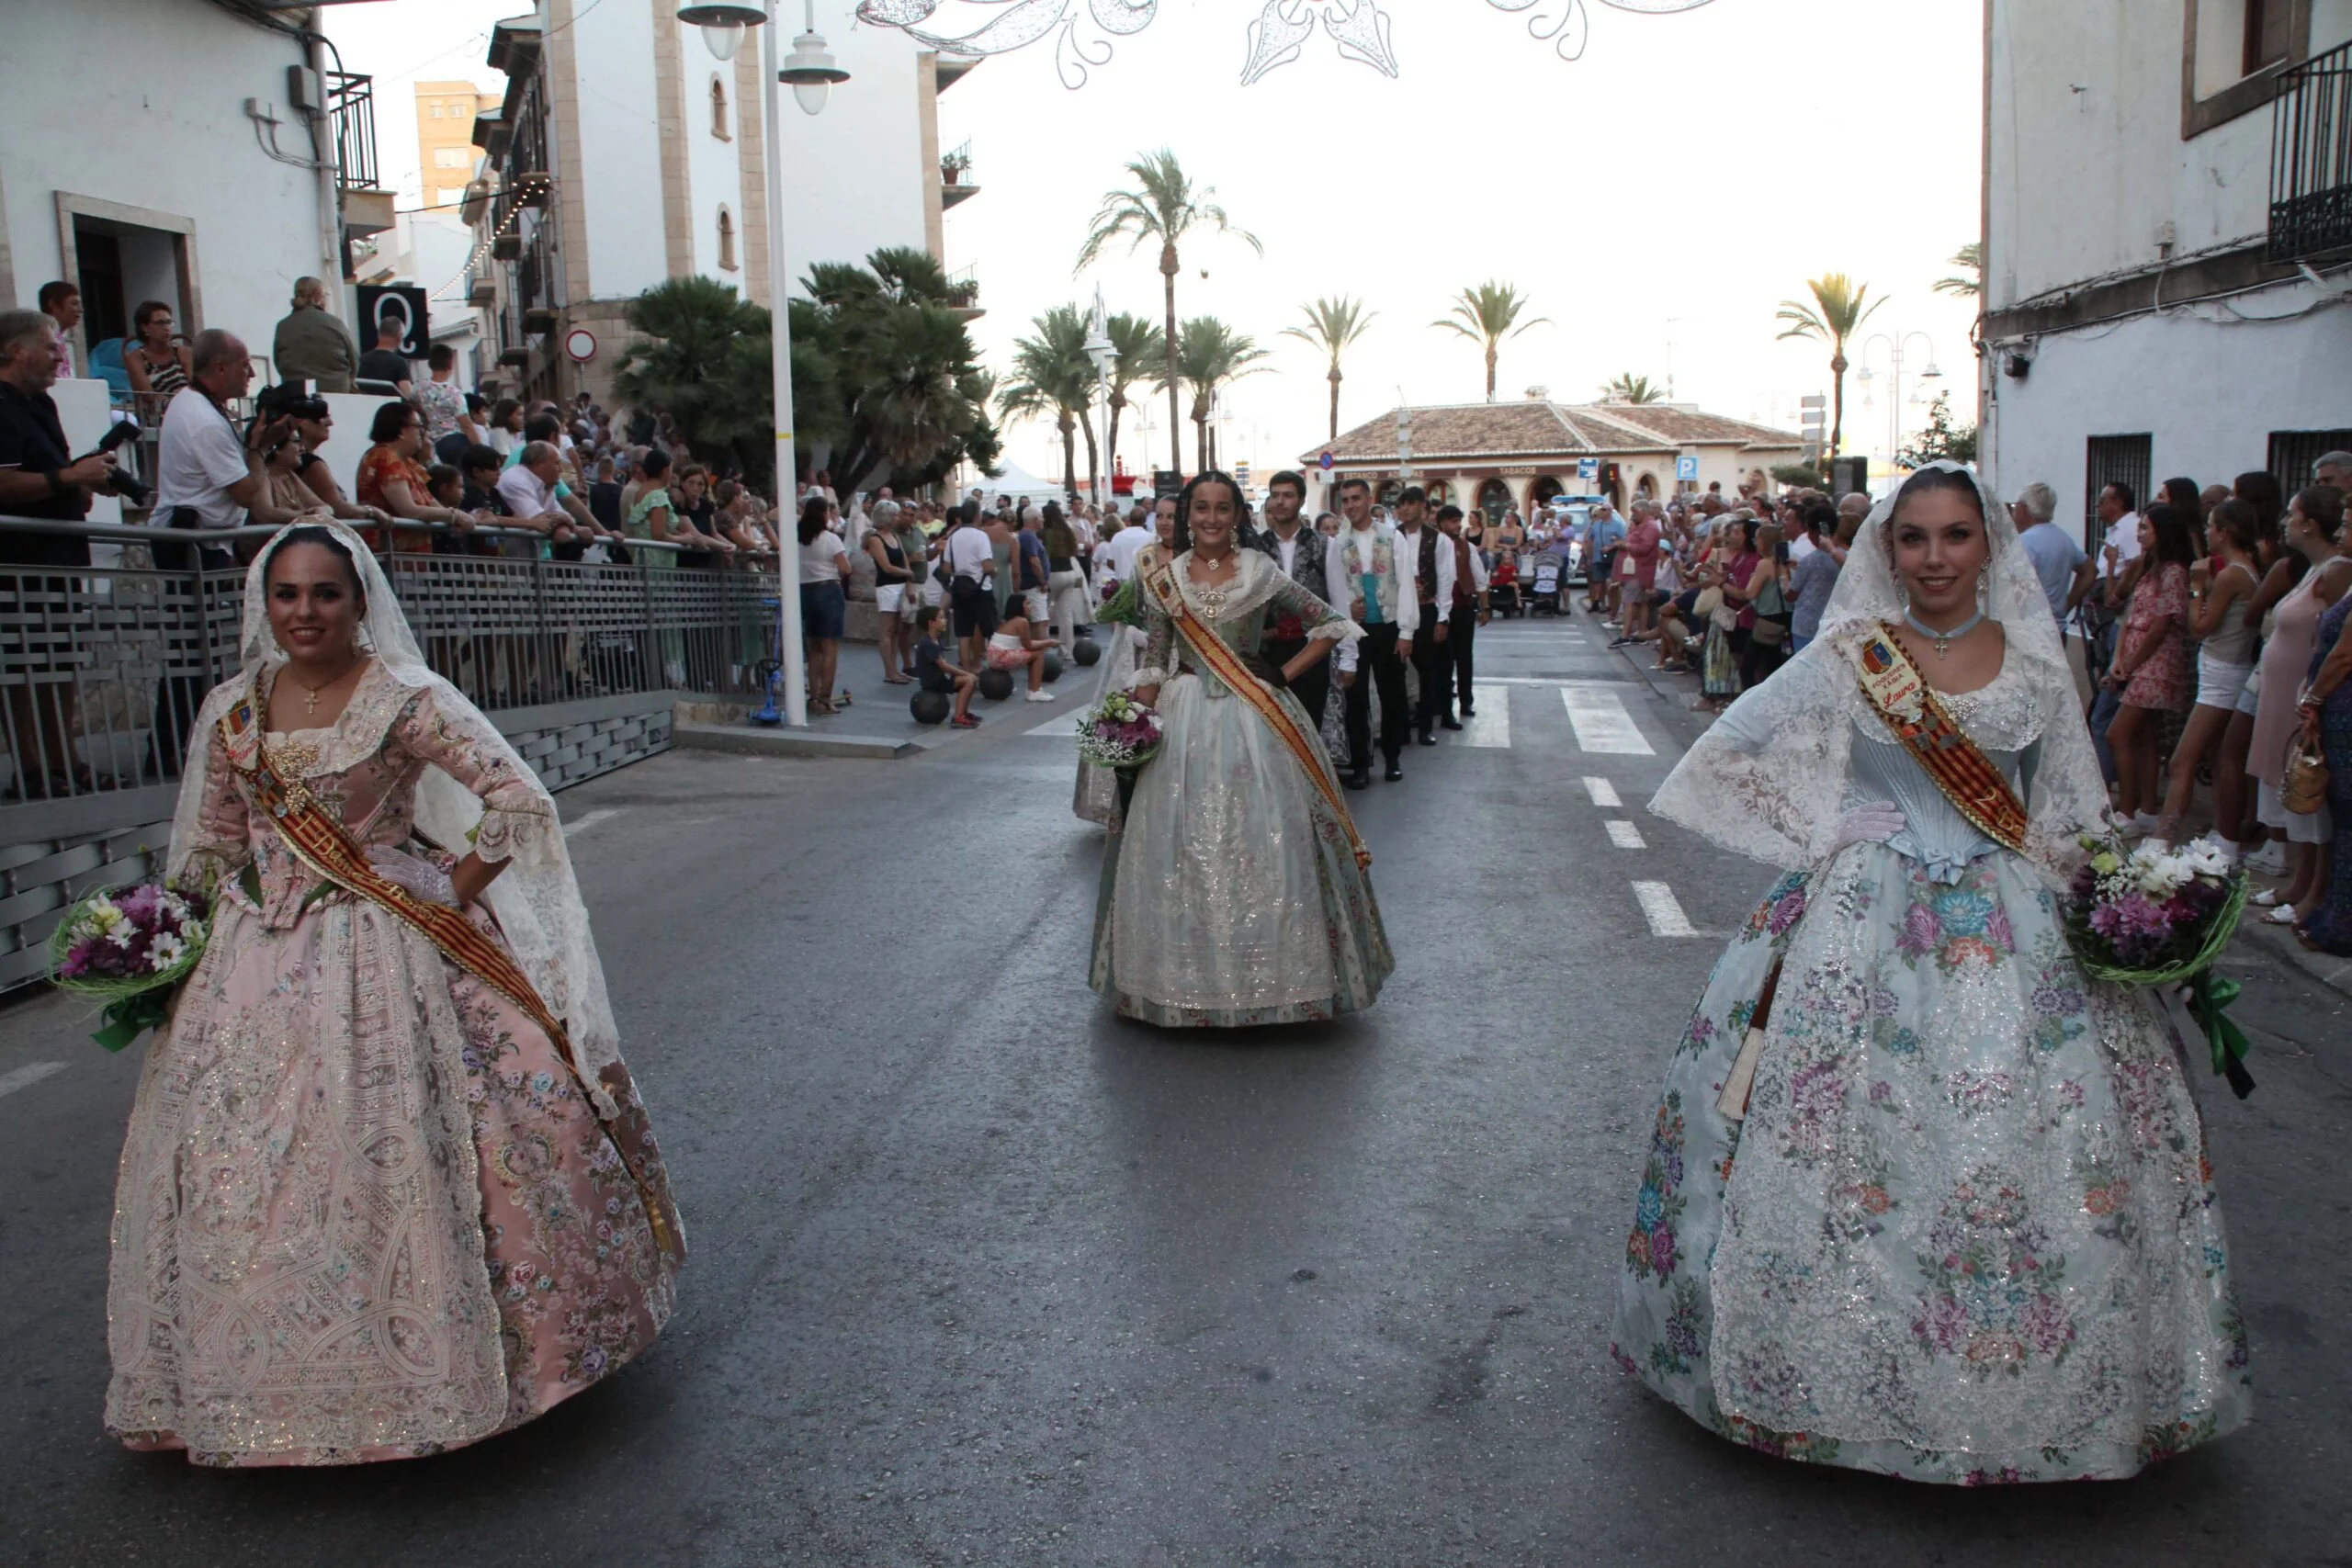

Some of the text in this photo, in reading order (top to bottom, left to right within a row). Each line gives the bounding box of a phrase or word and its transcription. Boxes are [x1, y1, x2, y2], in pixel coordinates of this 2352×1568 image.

[374, 292, 416, 354] Q
[1498, 466, 1537, 475] TABACOS
[1680, 458, 1694, 477] P
[1883, 682, 1916, 710] Laura
